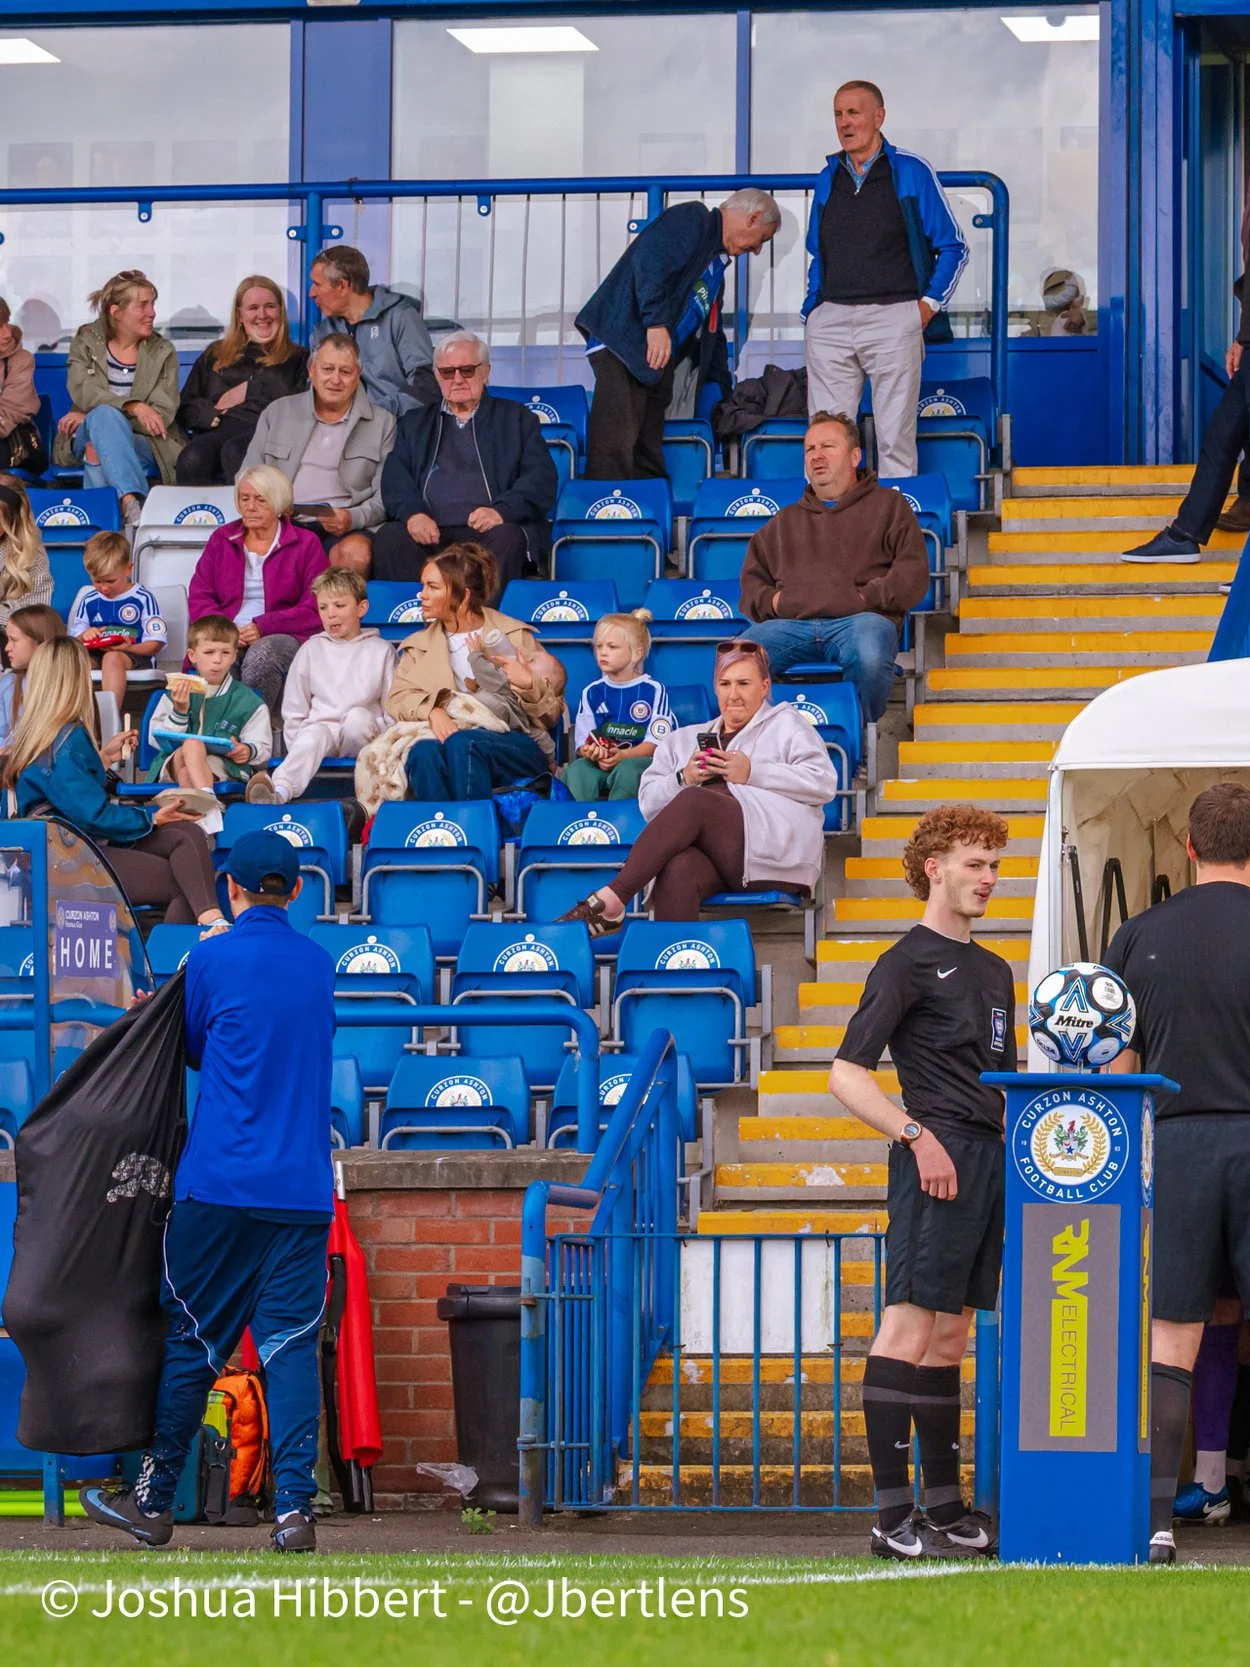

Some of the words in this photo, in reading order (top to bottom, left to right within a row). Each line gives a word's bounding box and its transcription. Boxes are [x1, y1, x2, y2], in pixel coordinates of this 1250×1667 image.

[607, 724, 638, 736] innacle
[410, 823, 436, 843] CURZON
[440, 823, 463, 843] ASHTON
[562, 822, 589, 841] CURZON
[593, 822, 617, 841] ASHTON
[61, 937, 113, 969] HOME
[342, 946, 370, 967] CURZON
[373, 946, 397, 968] ASHTON
[500, 944, 527, 966] CURZON
[530, 944, 555, 967] ASHTON
[660, 943, 688, 965] CURZON
[691, 943, 716, 965] ASHTON
[1055, 1015, 1093, 1028] Mitre
[431, 1078, 460, 1100] CURZON
[463, 1078, 489, 1101] ASHTON
[1021, 1091, 1071, 1129] CURZON
[1078, 1092, 1123, 1137] ASHTON
[1020, 1156, 1084, 1200] FOOTBALL
[1089, 1161, 1119, 1193] CLUB
[1060, 1304, 1078, 1431] ELECTRICAL
